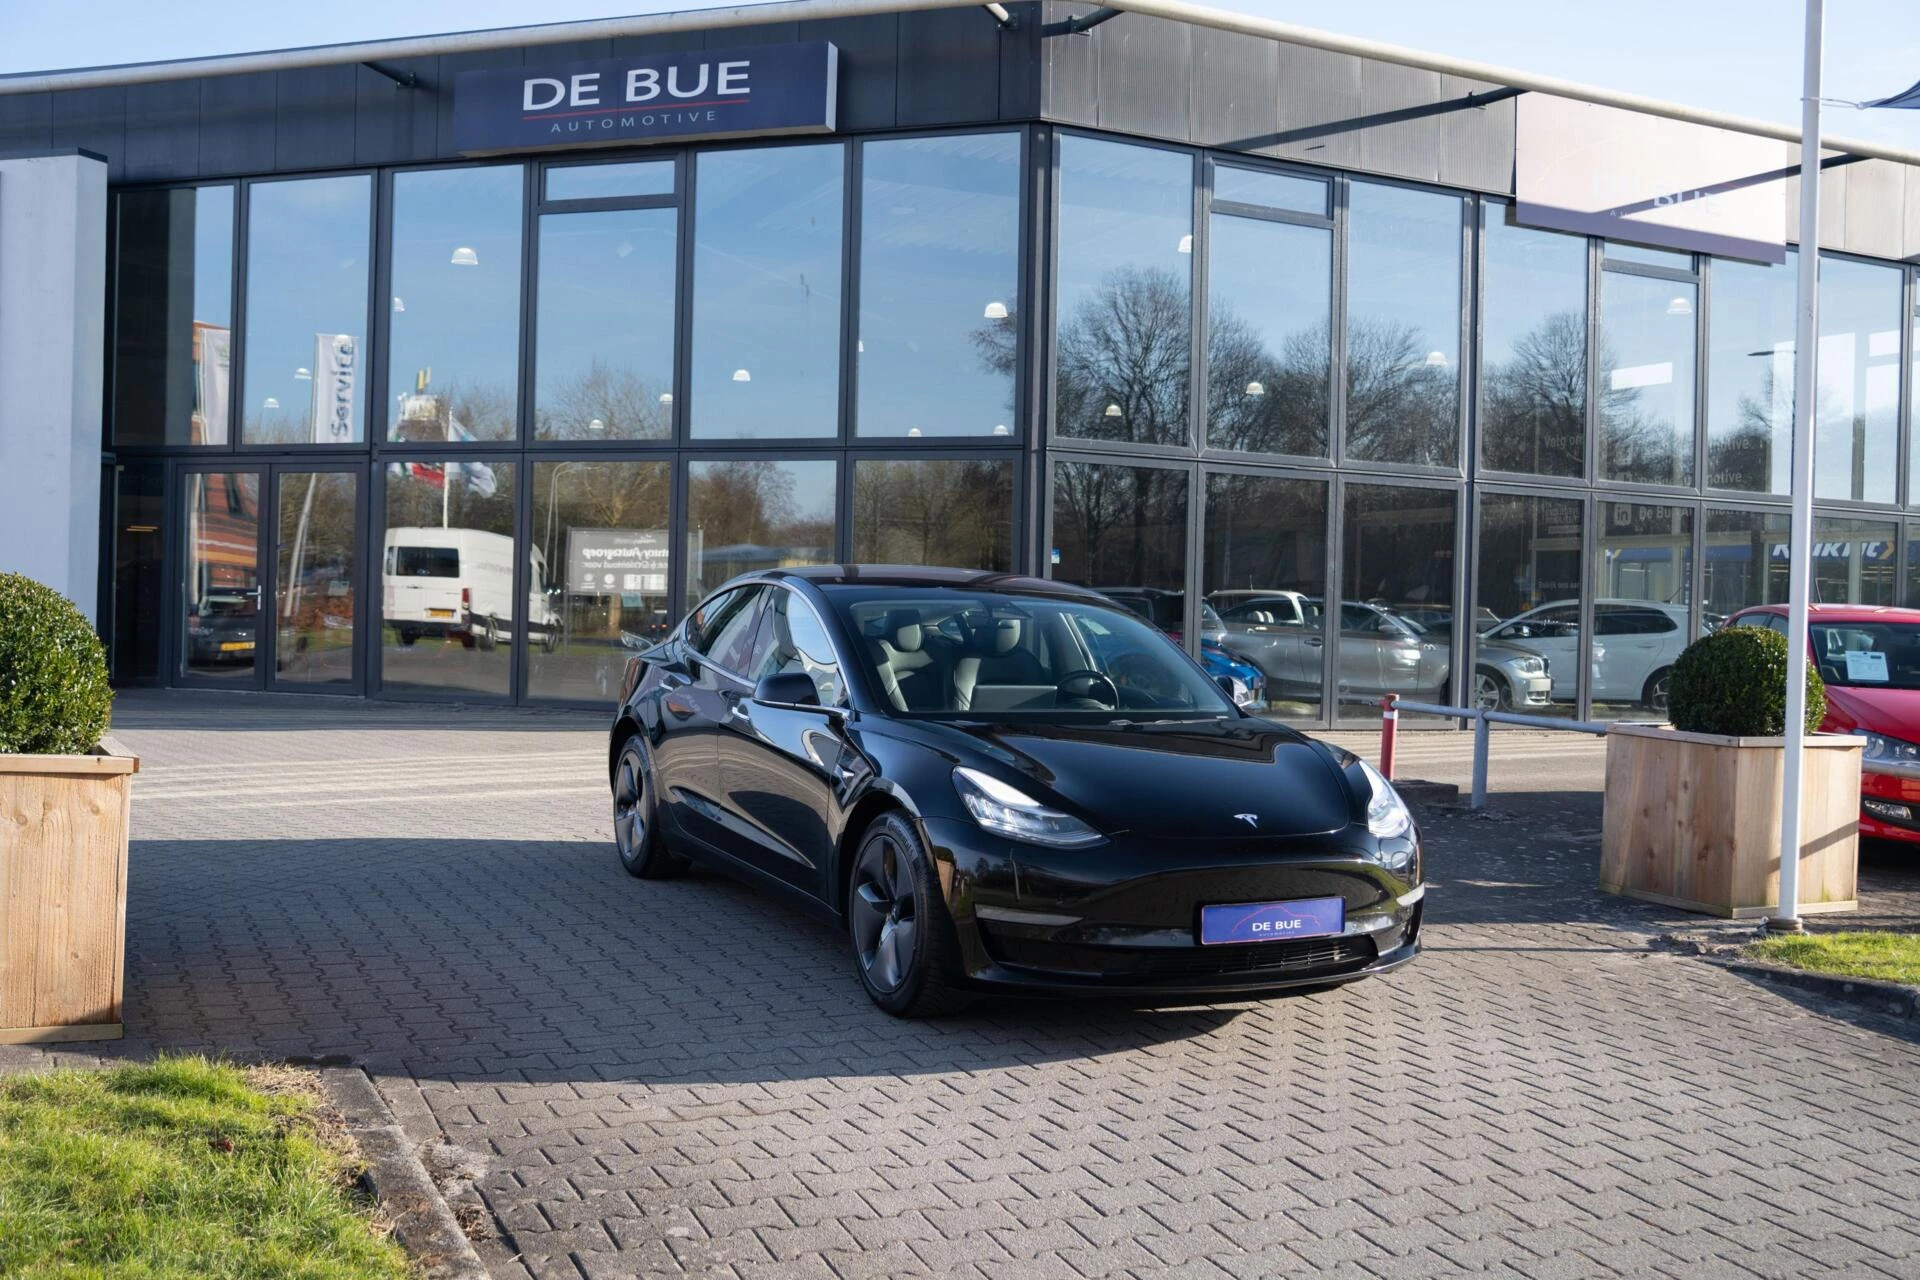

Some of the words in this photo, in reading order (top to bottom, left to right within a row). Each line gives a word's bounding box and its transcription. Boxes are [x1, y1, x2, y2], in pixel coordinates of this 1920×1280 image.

[523, 73, 600, 111] DE
[625, 61, 750, 102] BUE
[551, 111, 716, 133] AUTOMOTIVE
[1252, 922, 1271, 931] DE
[1275, 919, 1301, 930] BUE
